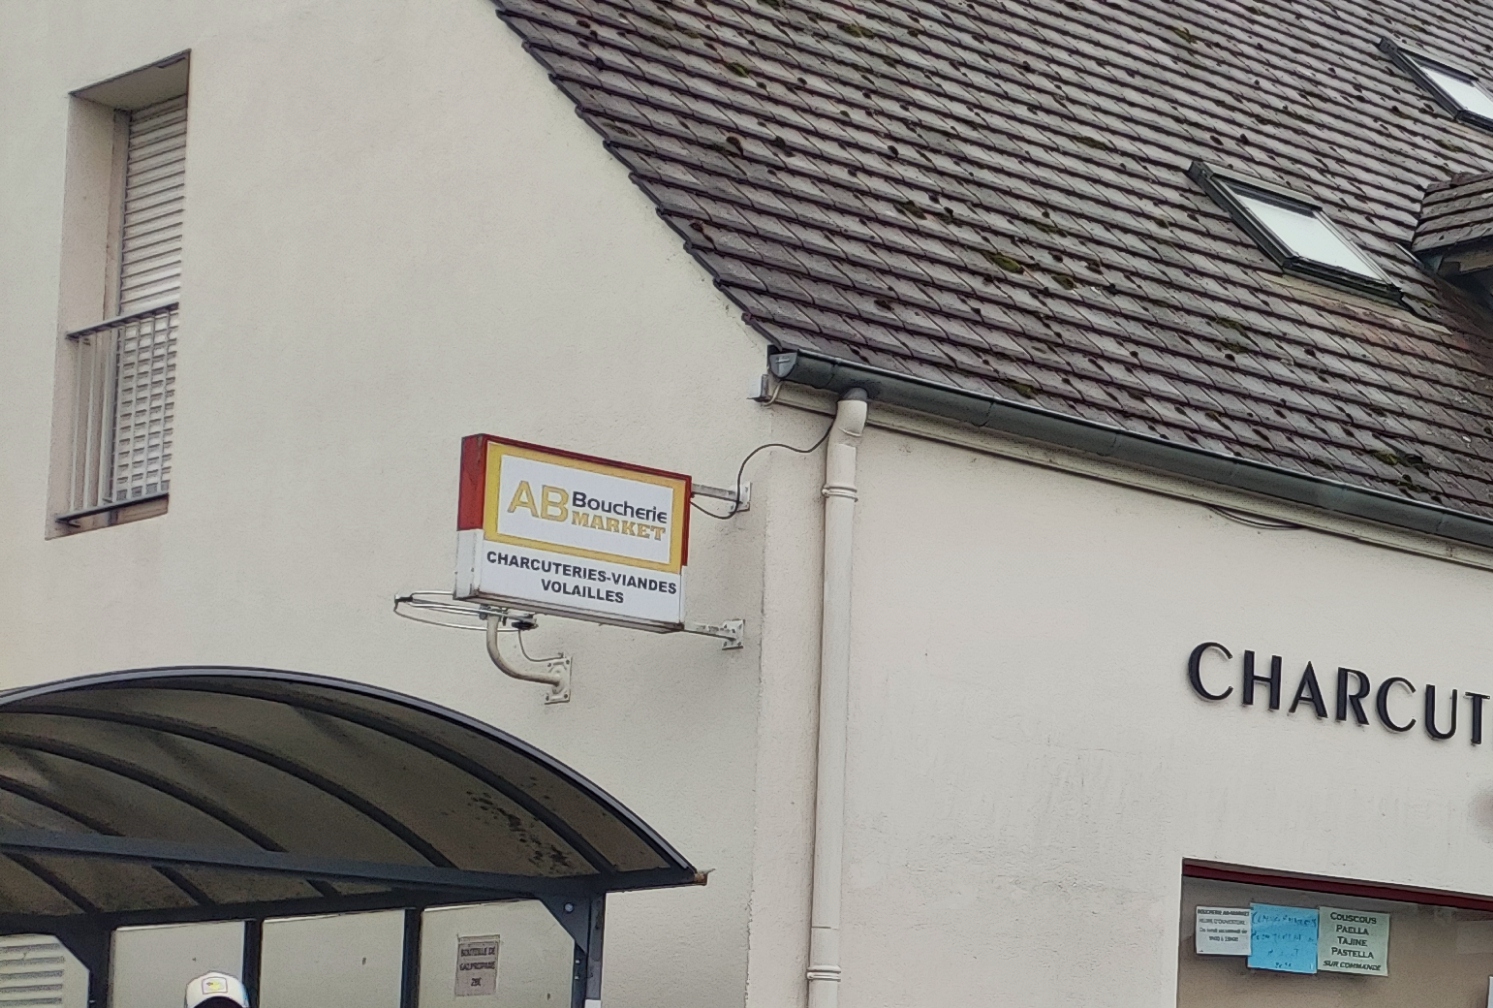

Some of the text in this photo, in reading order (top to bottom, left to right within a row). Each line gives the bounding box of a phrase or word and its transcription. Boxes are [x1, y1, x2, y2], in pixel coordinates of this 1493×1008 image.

[507, 480, 569, 523] AB
[571, 491, 668, 524] Boucherie
[570, 511, 667, 541] MARKET
[486, 550, 678, 595] CHARCUTERIES-VIANDES
[540, 578, 625, 604] VOLAILLES
[1330, 911, 1377, 925] COUSCOUS
[1335, 924, 1370, 936] PAELLA
[1331, 946, 1375, 960] PASTELLA
[1337, 935, 1368, 947] TAJINE
